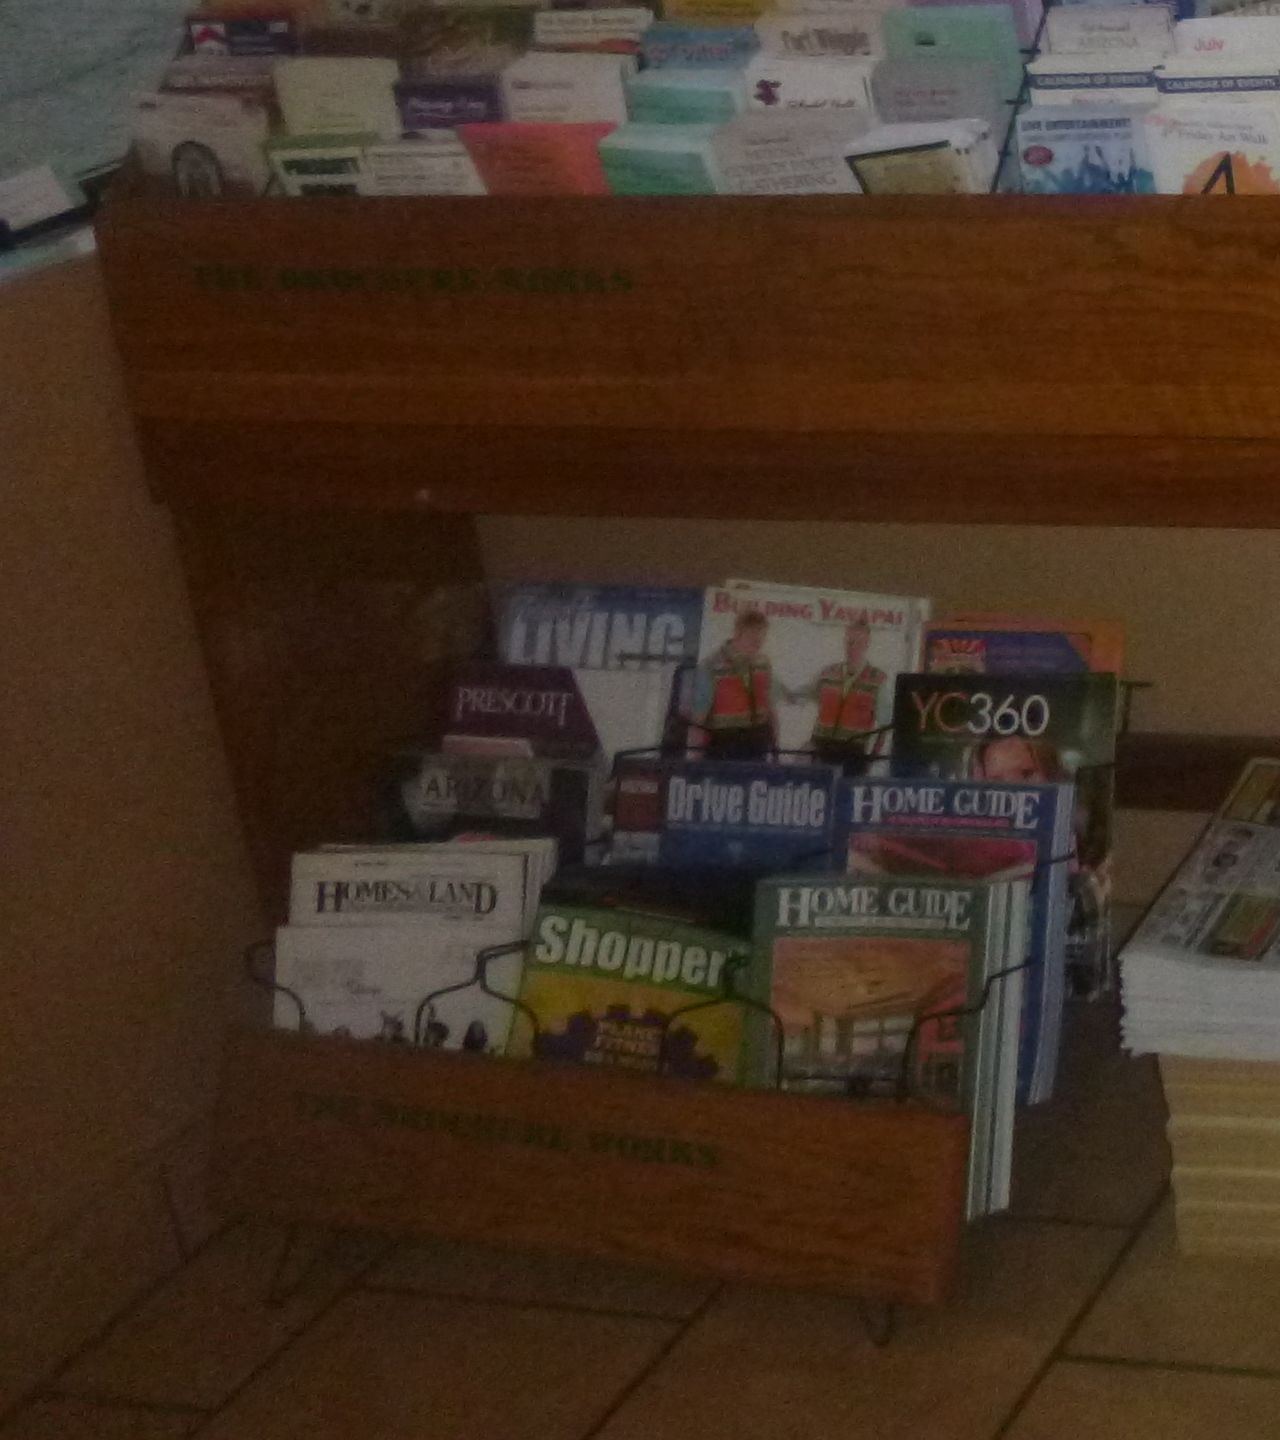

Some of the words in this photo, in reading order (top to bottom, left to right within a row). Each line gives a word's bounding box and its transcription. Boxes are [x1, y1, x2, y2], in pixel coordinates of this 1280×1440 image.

[456, 686, 574, 727] PRESCOTT
[911, 690, 1050, 737] YC360
[666, 775, 744, 825] Drive
[747, 776, 827, 828] Guide
[851, 785, 946, 824] HOME
[953, 788, 1041, 831] GUIDE
[428, 880, 498, 915] LAND
[775, 886, 880, 928] HOME
[887, 886, 972, 932] GUIDE
[534, 913, 729, 989] Shopper
